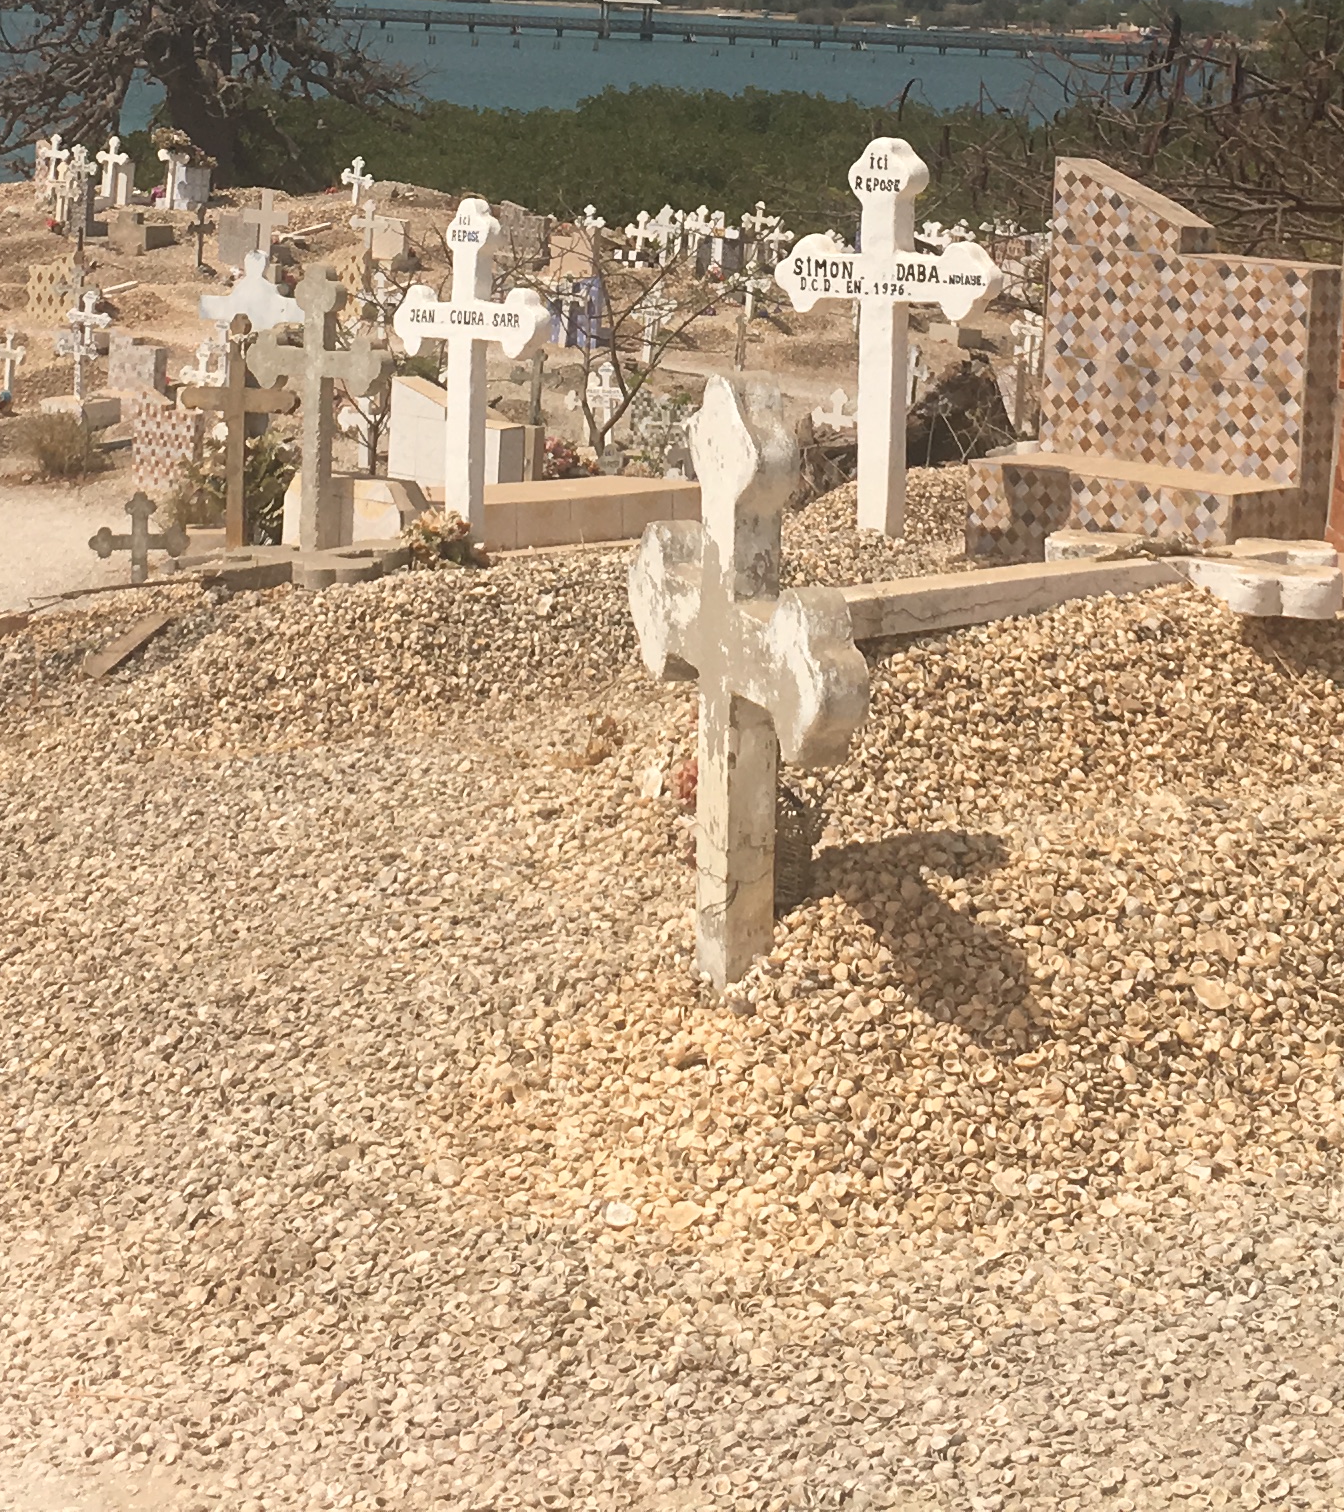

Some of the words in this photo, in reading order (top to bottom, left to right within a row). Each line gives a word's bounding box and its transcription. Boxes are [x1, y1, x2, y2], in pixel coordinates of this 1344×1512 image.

[854, 175, 901, 193] REPOSE
[451, 229, 480, 243] REPOSE
[896, 263, 941, 284] DABA
[409, 308, 435, 324] JEAN
[449, 309, 485, 326] COURA
[491, 312, 521, 328] SARR
